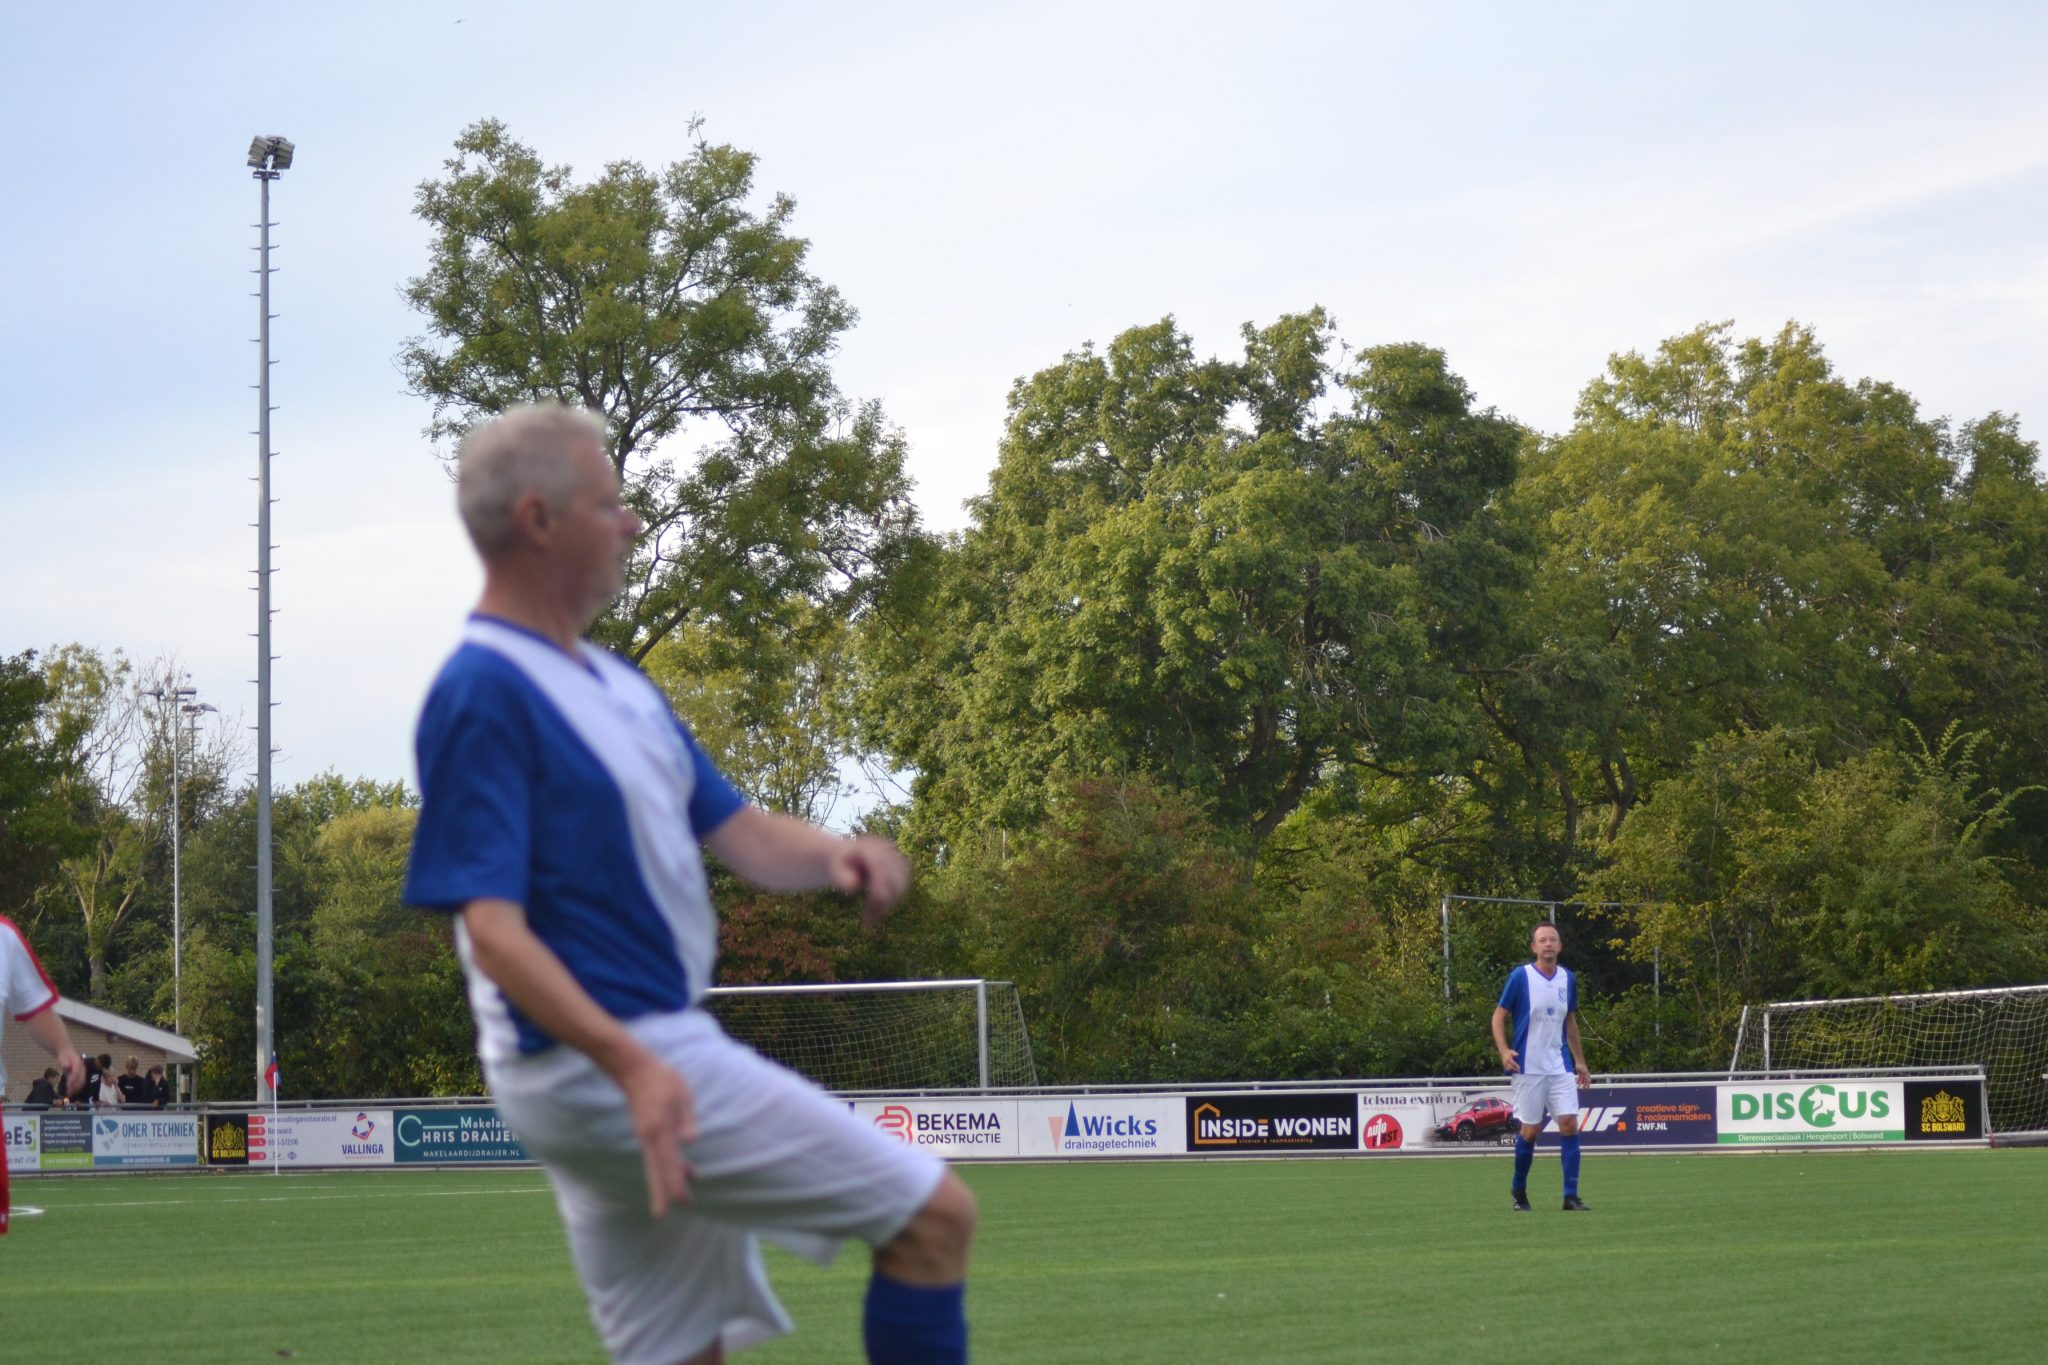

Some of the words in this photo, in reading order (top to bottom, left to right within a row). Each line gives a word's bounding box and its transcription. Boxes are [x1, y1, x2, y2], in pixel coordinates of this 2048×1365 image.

[1636, 1104, 1677, 1113] creatieve
[1732, 1084, 1889, 1128] DISCUS
[917, 1113, 1001, 1131] BEKEMA
[1644, 1112, 1712, 1121] reclamemakers
[122, 1122, 148, 1138] OMER
[151, 1122, 195, 1137] TECHNIEK
[1082, 1115, 1157, 1136] Wicks
[1200, 1118, 1269, 1138] INSIDE
[1274, 1117, 1352, 1136] WONEN
[1636, 1122, 1668, 1131] ZWF.NL
[1921, 1122, 1931, 1132] SC
[1932, 1122, 1966, 1132] BOLSWARD
[917, 1132, 1001, 1144] CONSTRUCTIE
[1738, 1133, 1801, 1142] Dierenspeciaalzaak
[1806, 1132, 1848, 1142] Hengelsport
[1852, 1131, 1884, 1140] Bolsward
[341, 1143, 385, 1155] VALLINGA
[1064, 1138, 1157, 1151] drainagetechniek
[423, 1149, 521, 1158] MAKELAARDIJDRAIJER.NL
